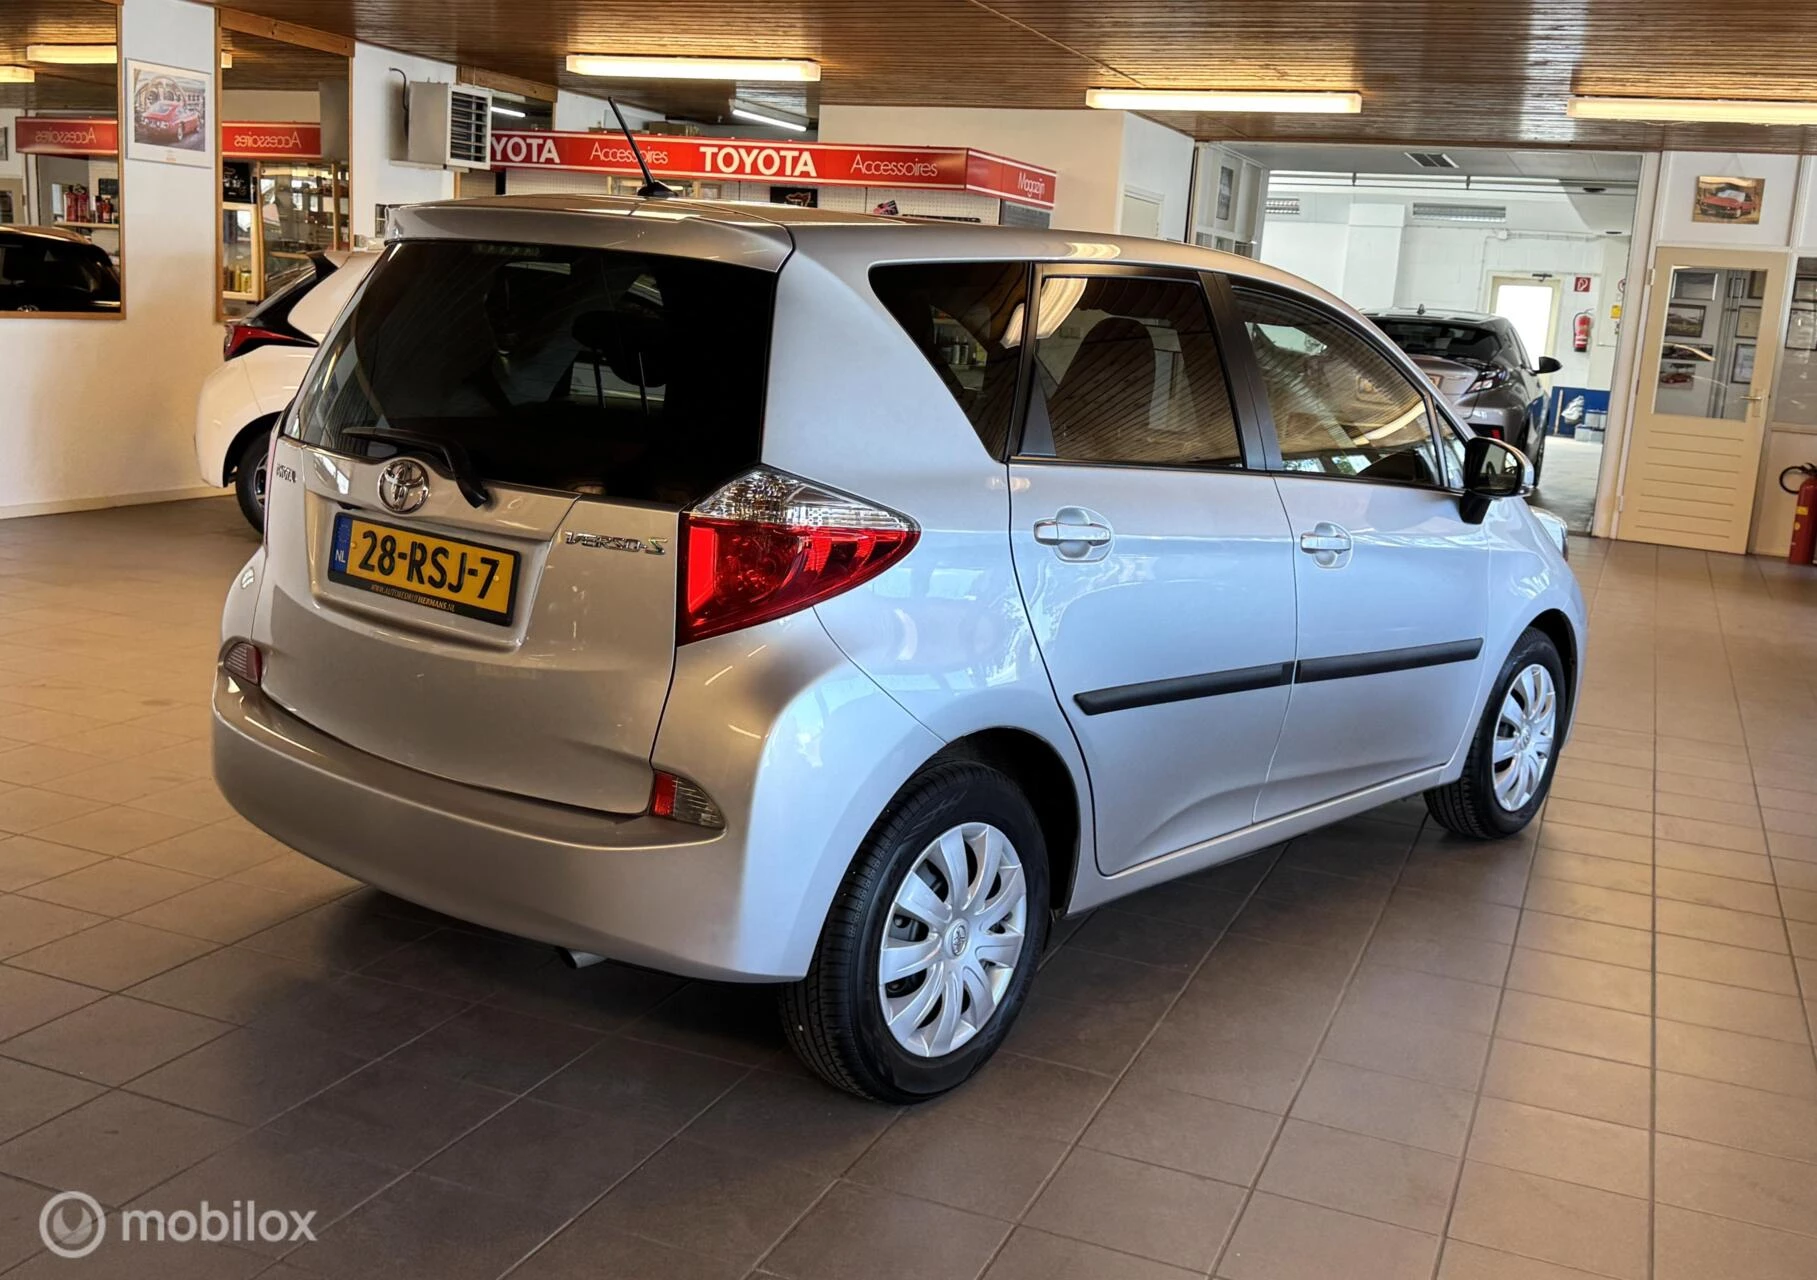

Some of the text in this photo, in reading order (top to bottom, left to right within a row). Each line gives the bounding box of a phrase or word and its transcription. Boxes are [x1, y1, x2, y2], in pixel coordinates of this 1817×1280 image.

[491, 136, 560, 163] YOTA
[699, 146, 818, 177] TOYOTA
[850, 154, 938, 177] Accessoires
[335, 549, 346, 564] NL
[564, 531, 668, 556] VERSO-S
[358, 529, 500, 599] 28-RSJ-7
